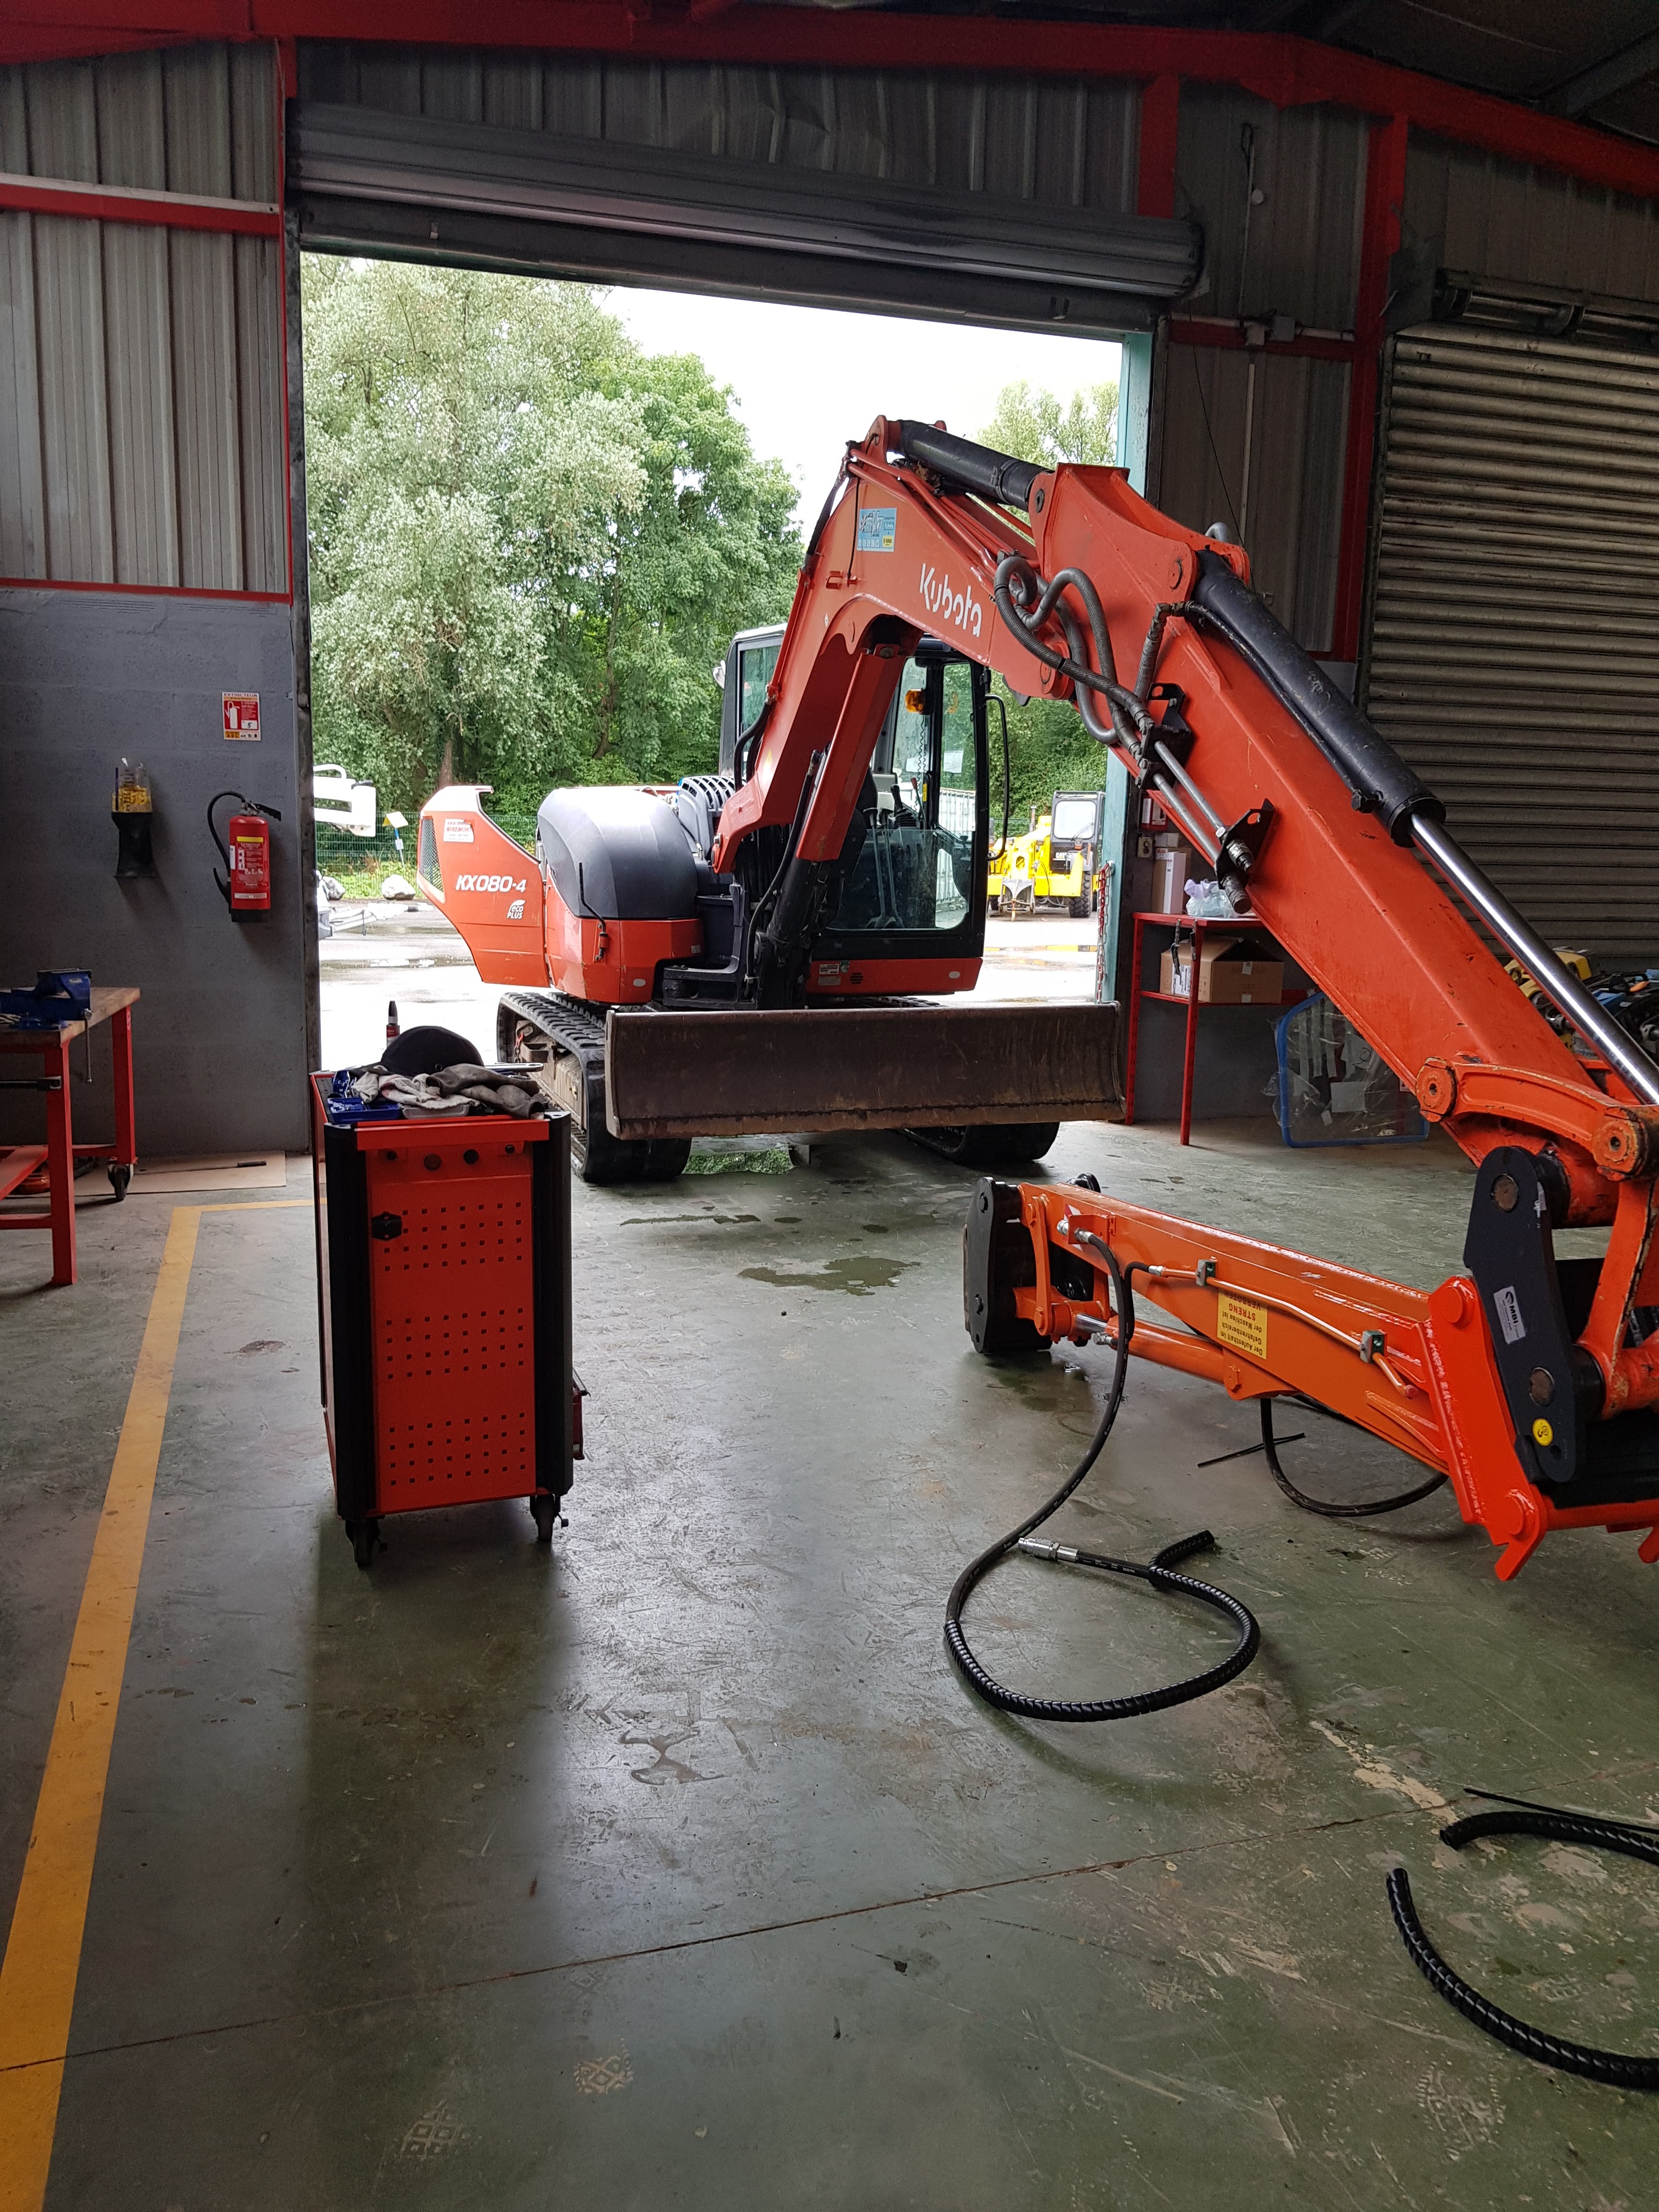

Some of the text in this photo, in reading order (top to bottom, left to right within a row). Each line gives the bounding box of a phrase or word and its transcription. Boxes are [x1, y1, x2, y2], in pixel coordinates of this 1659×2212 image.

[919, 563, 982, 637] Kubota
[455, 874, 527, 893] KX080-4
[1228, 1303, 1256, 1321] STRENG
[1509, 1305, 1519, 1324] MBI
[1229, 1314, 1252, 1330] Maschine
[1254, 1324, 1262, 1333] der
[1222, 1322, 1262, 1345] Gefahrenbereich
[1227, 1334, 1253, 1351] Aufenthalt
[1254, 1346, 1263, 1356] Der
